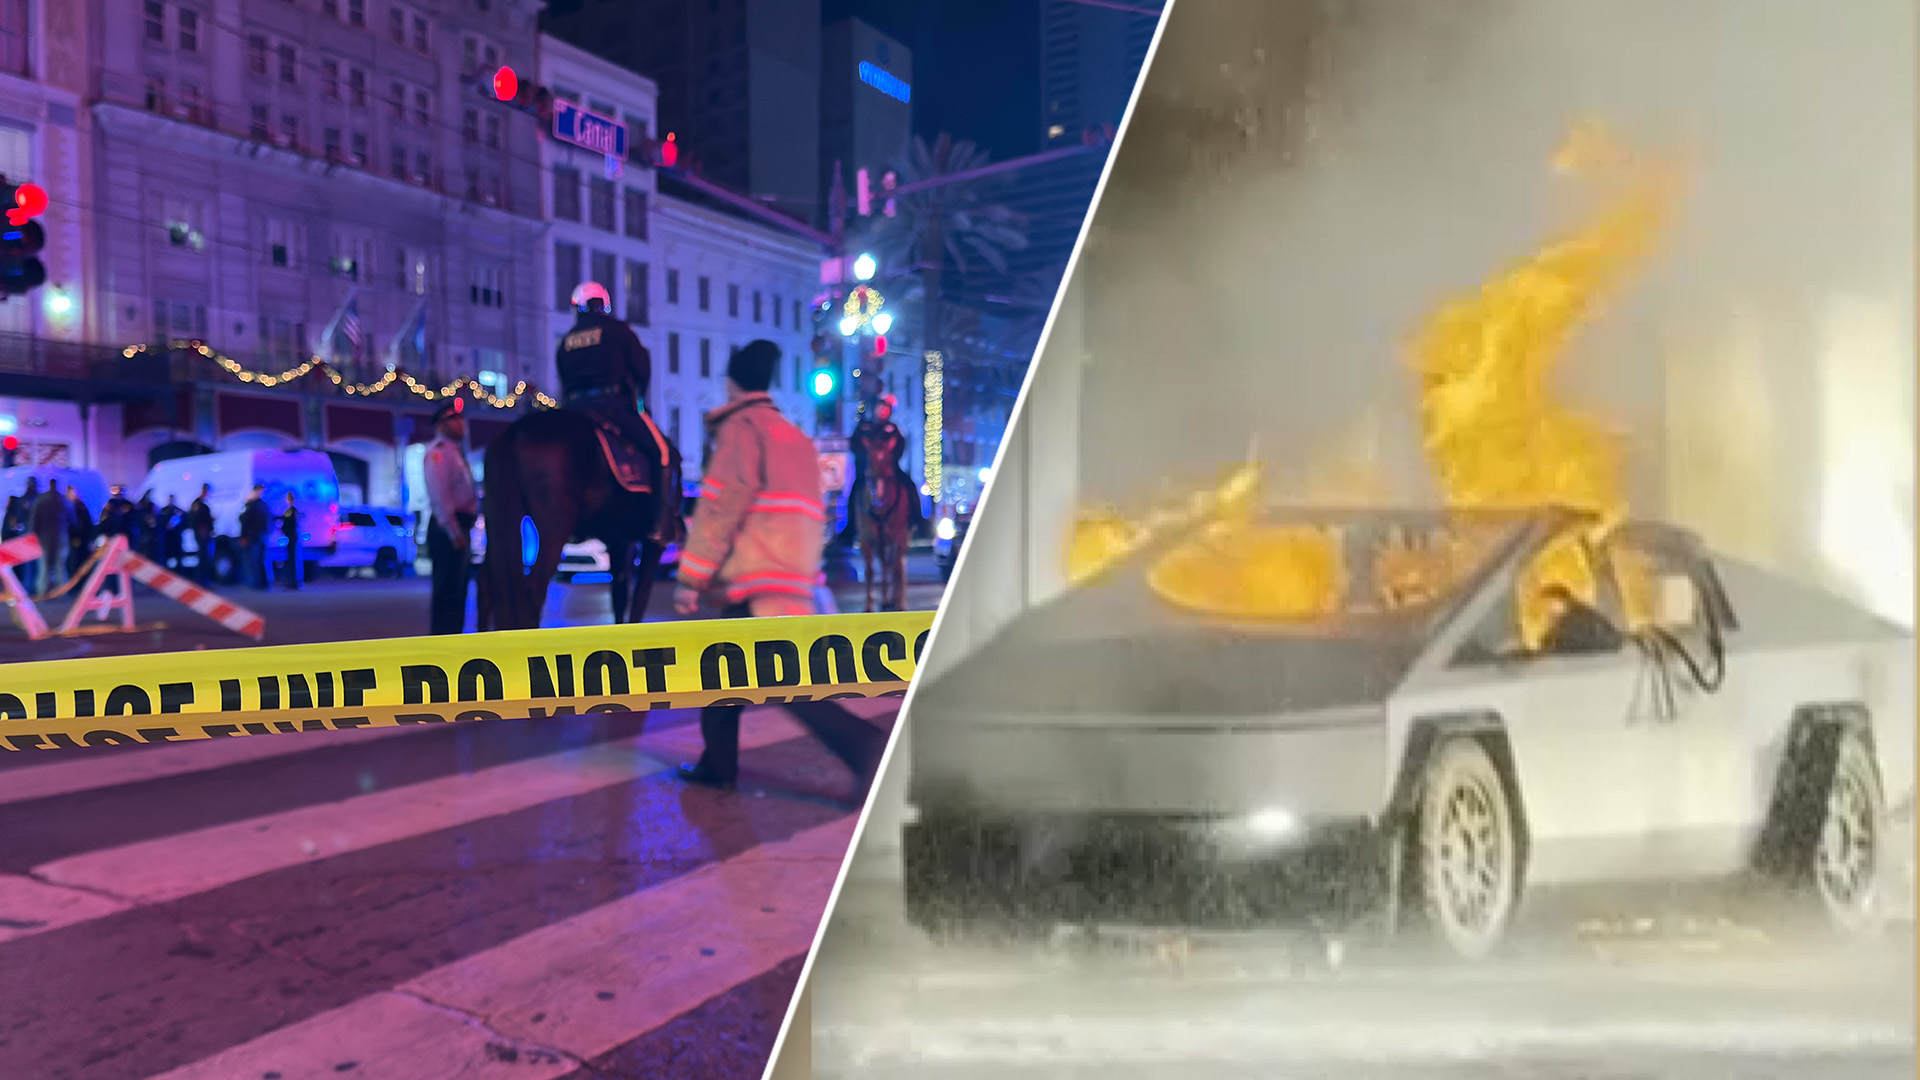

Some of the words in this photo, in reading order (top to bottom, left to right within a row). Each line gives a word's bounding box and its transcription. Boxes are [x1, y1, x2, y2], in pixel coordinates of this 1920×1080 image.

[573, 110, 617, 154] Canal
[401, 658, 504, 706] DO
[527, 647, 677, 700] NOT
[700, 628, 931, 691] CROS
